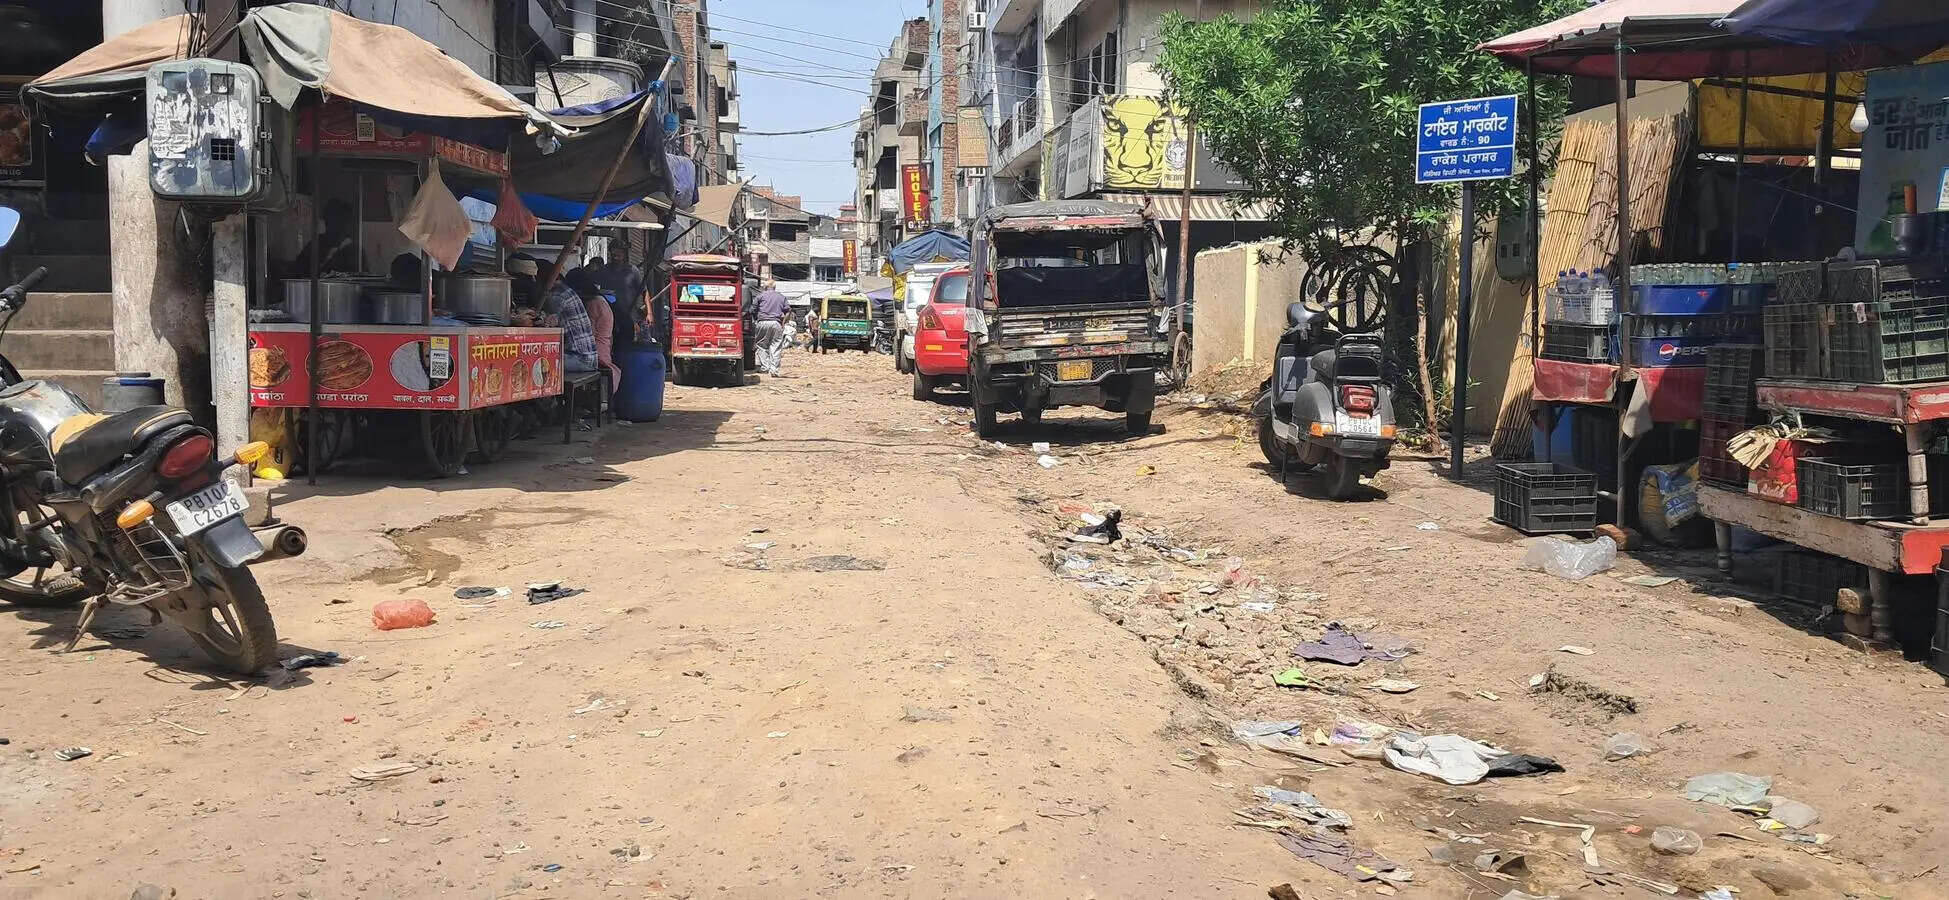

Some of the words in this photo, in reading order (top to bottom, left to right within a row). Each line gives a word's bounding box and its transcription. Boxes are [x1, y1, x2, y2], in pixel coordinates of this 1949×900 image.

[1424, 117, 1459, 137] ਟਾਇਰ
[1463, 112, 1508, 134] ਮਾਰਕੀਟ
[1477, 135, 1490, 144] 90
[911, 172, 923, 221] HOTEL
[1672, 346, 1709, 357] PEPS
[193, 497, 241, 527] C2678
